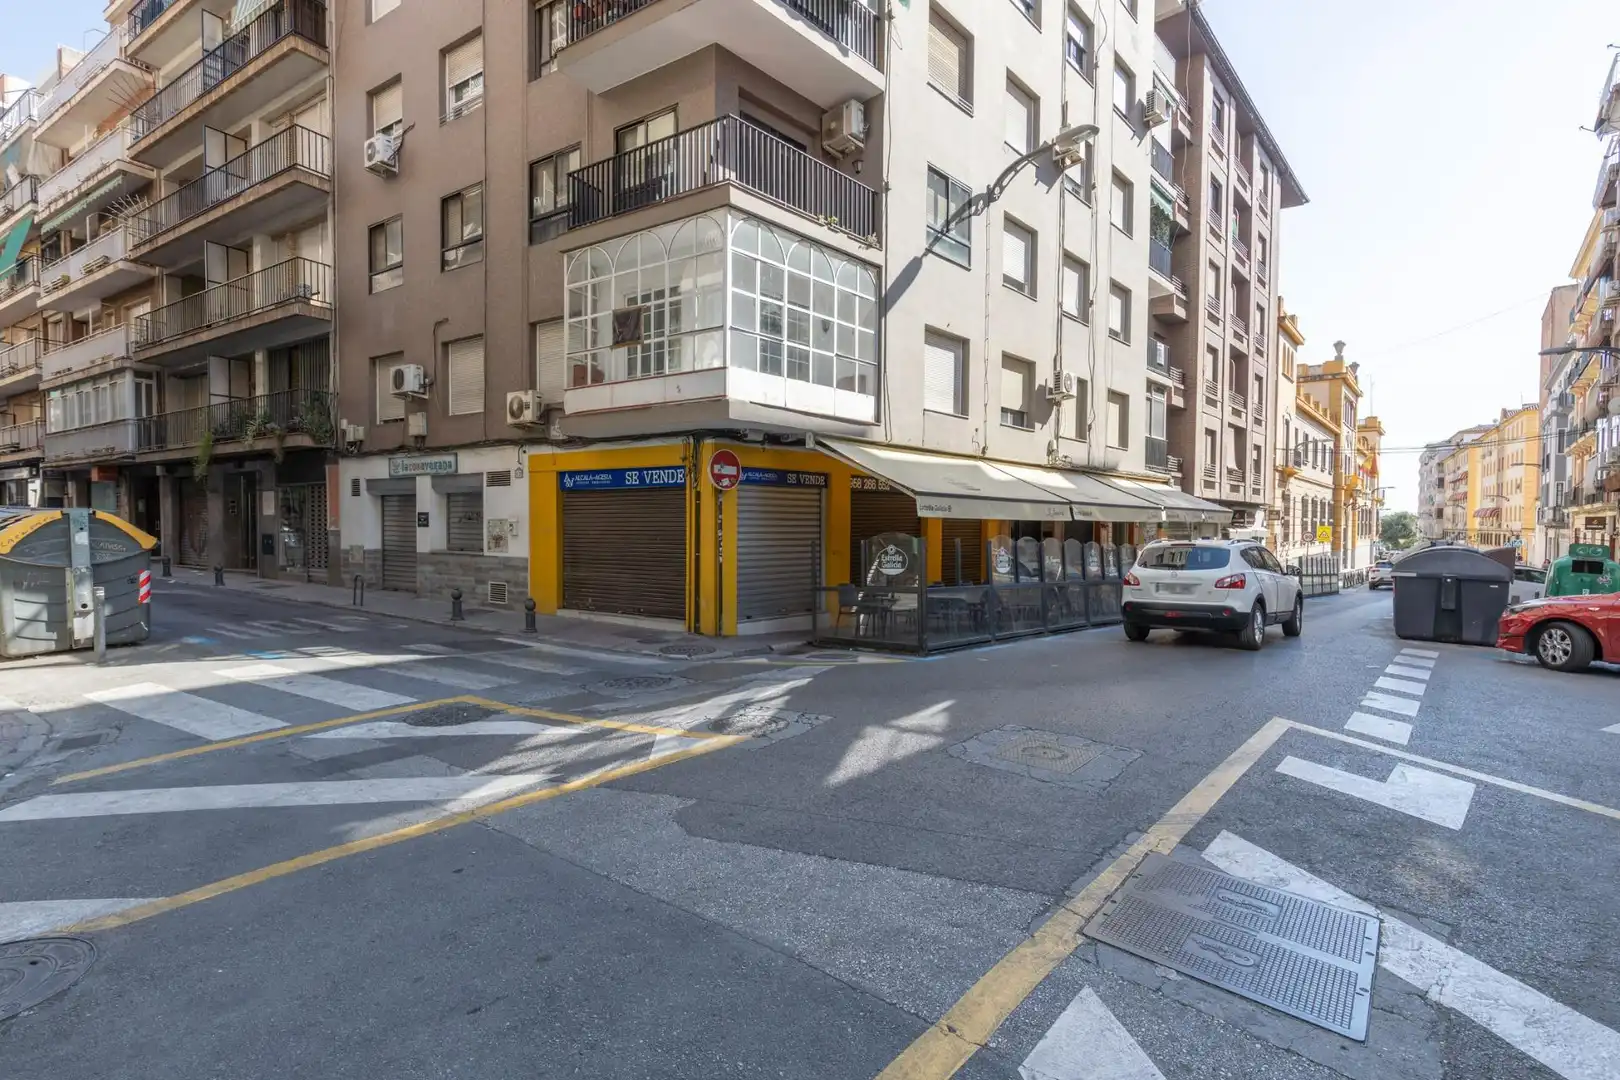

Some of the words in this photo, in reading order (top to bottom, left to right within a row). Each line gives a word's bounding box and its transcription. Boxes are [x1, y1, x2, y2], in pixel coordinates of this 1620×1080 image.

[625, 471, 639, 484] SE
[643, 469, 685, 484] VENDE
[786, 473, 797, 484] SE
[799, 474, 826, 485] VENDE
